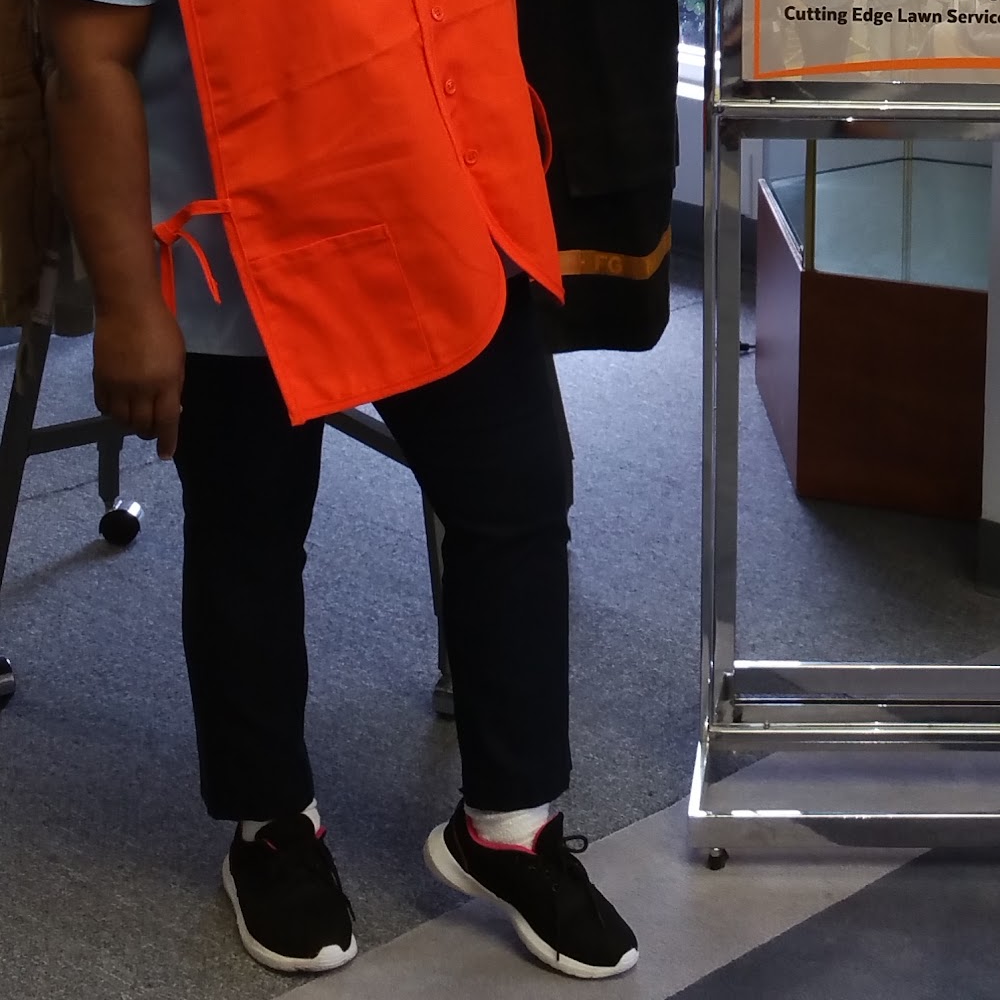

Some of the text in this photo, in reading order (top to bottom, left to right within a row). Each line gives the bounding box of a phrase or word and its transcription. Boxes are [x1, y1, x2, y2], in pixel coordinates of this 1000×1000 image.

[784, 5, 848, 26] Cutting
[852, 7, 893, 26] Edge
[897, 7, 943, 24] Lawn
